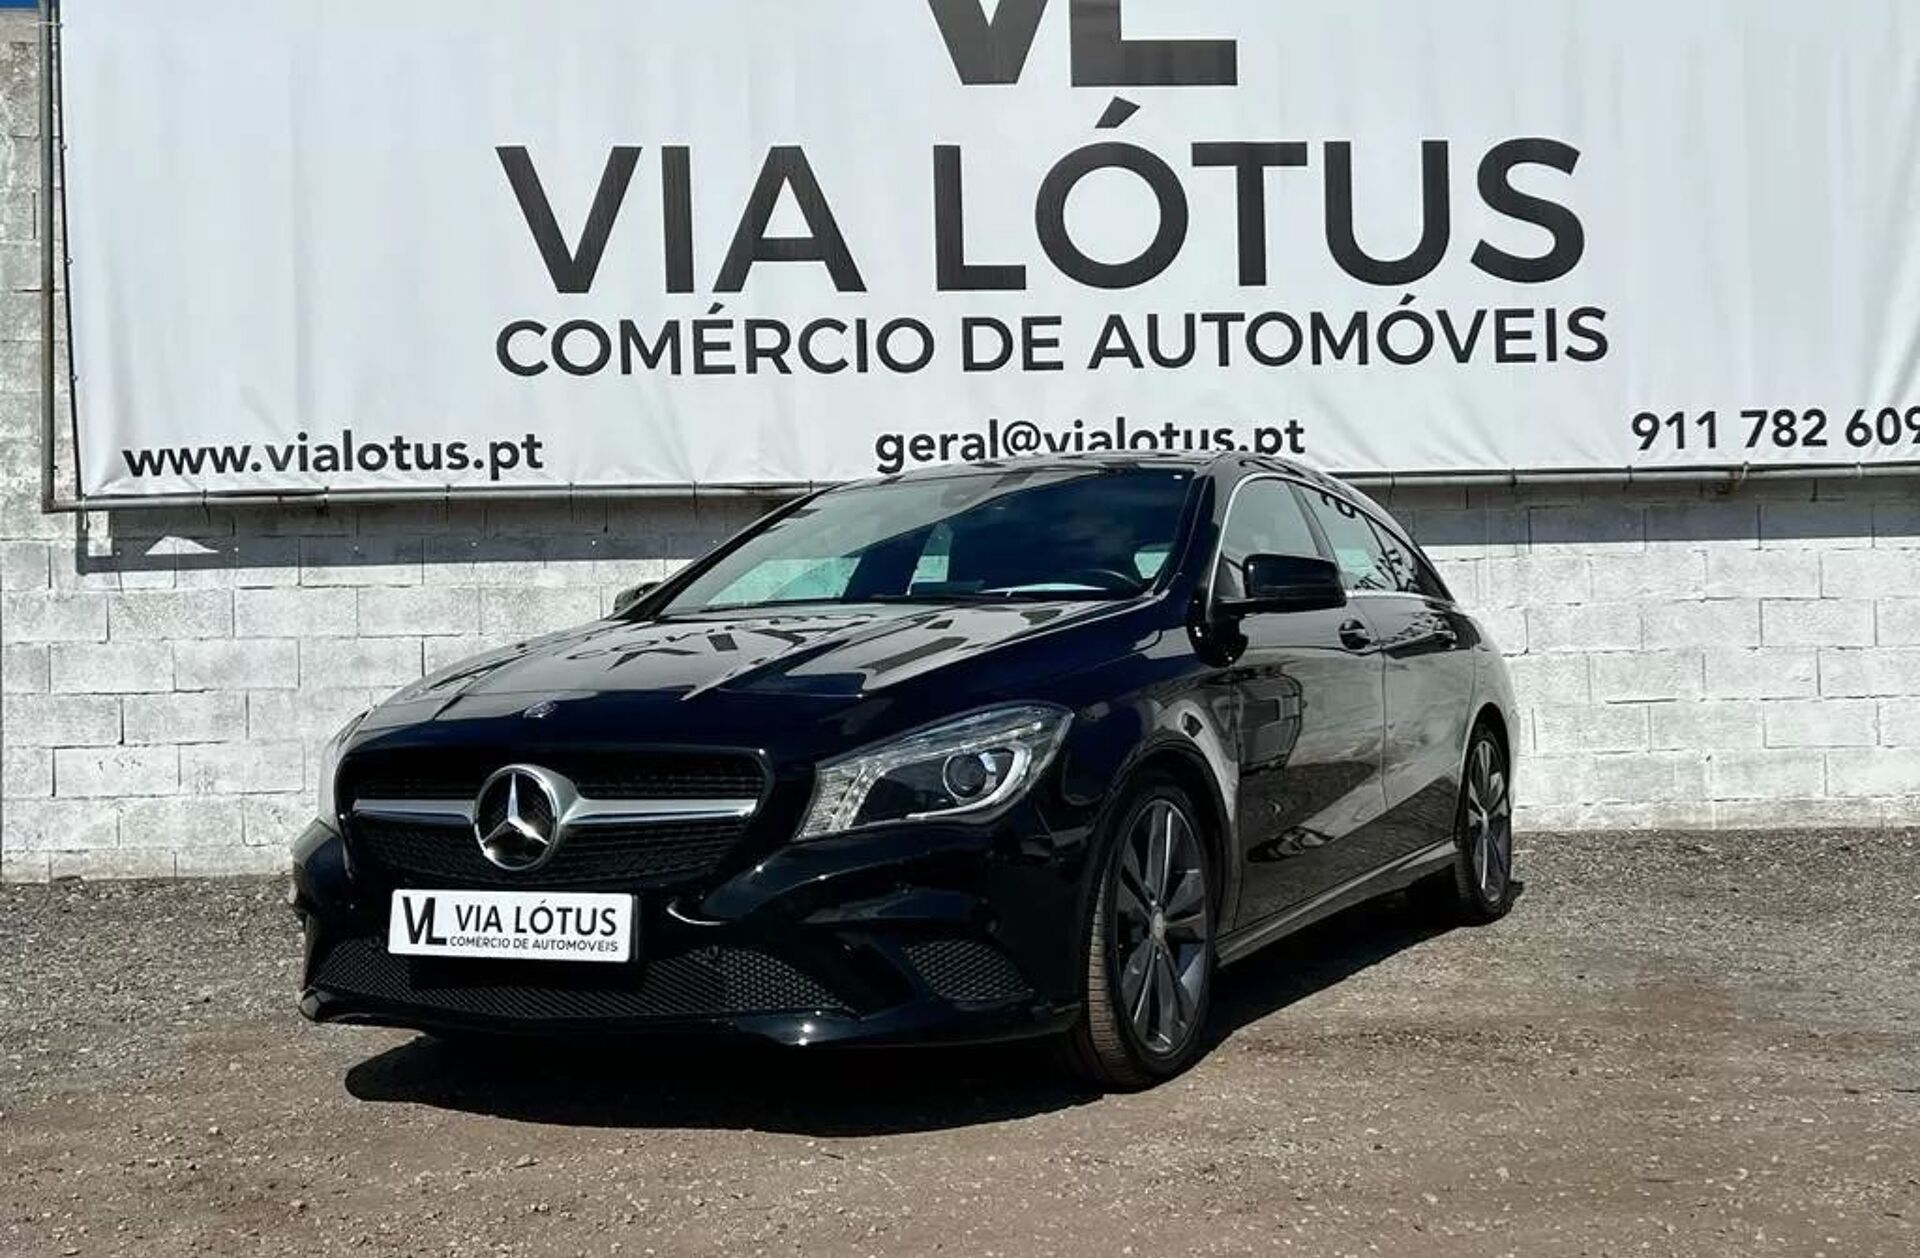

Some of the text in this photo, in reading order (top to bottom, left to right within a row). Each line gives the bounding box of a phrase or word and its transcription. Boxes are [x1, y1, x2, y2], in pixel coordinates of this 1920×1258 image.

[496, 97, 1584, 293] VIA LÓTUS
[497, 294, 1609, 376] COMÉRCIO DE AUTOMÓVEIS
[1632, 411, 1717, 450] 911
[1740, 409, 1827, 448] 782
[122, 430, 543, 479] www.vialotus.pt
[402, 897, 447, 946] VL
[455, 899, 617, 939] VIA LÓTUS
[513, 938, 529, 950] DE
